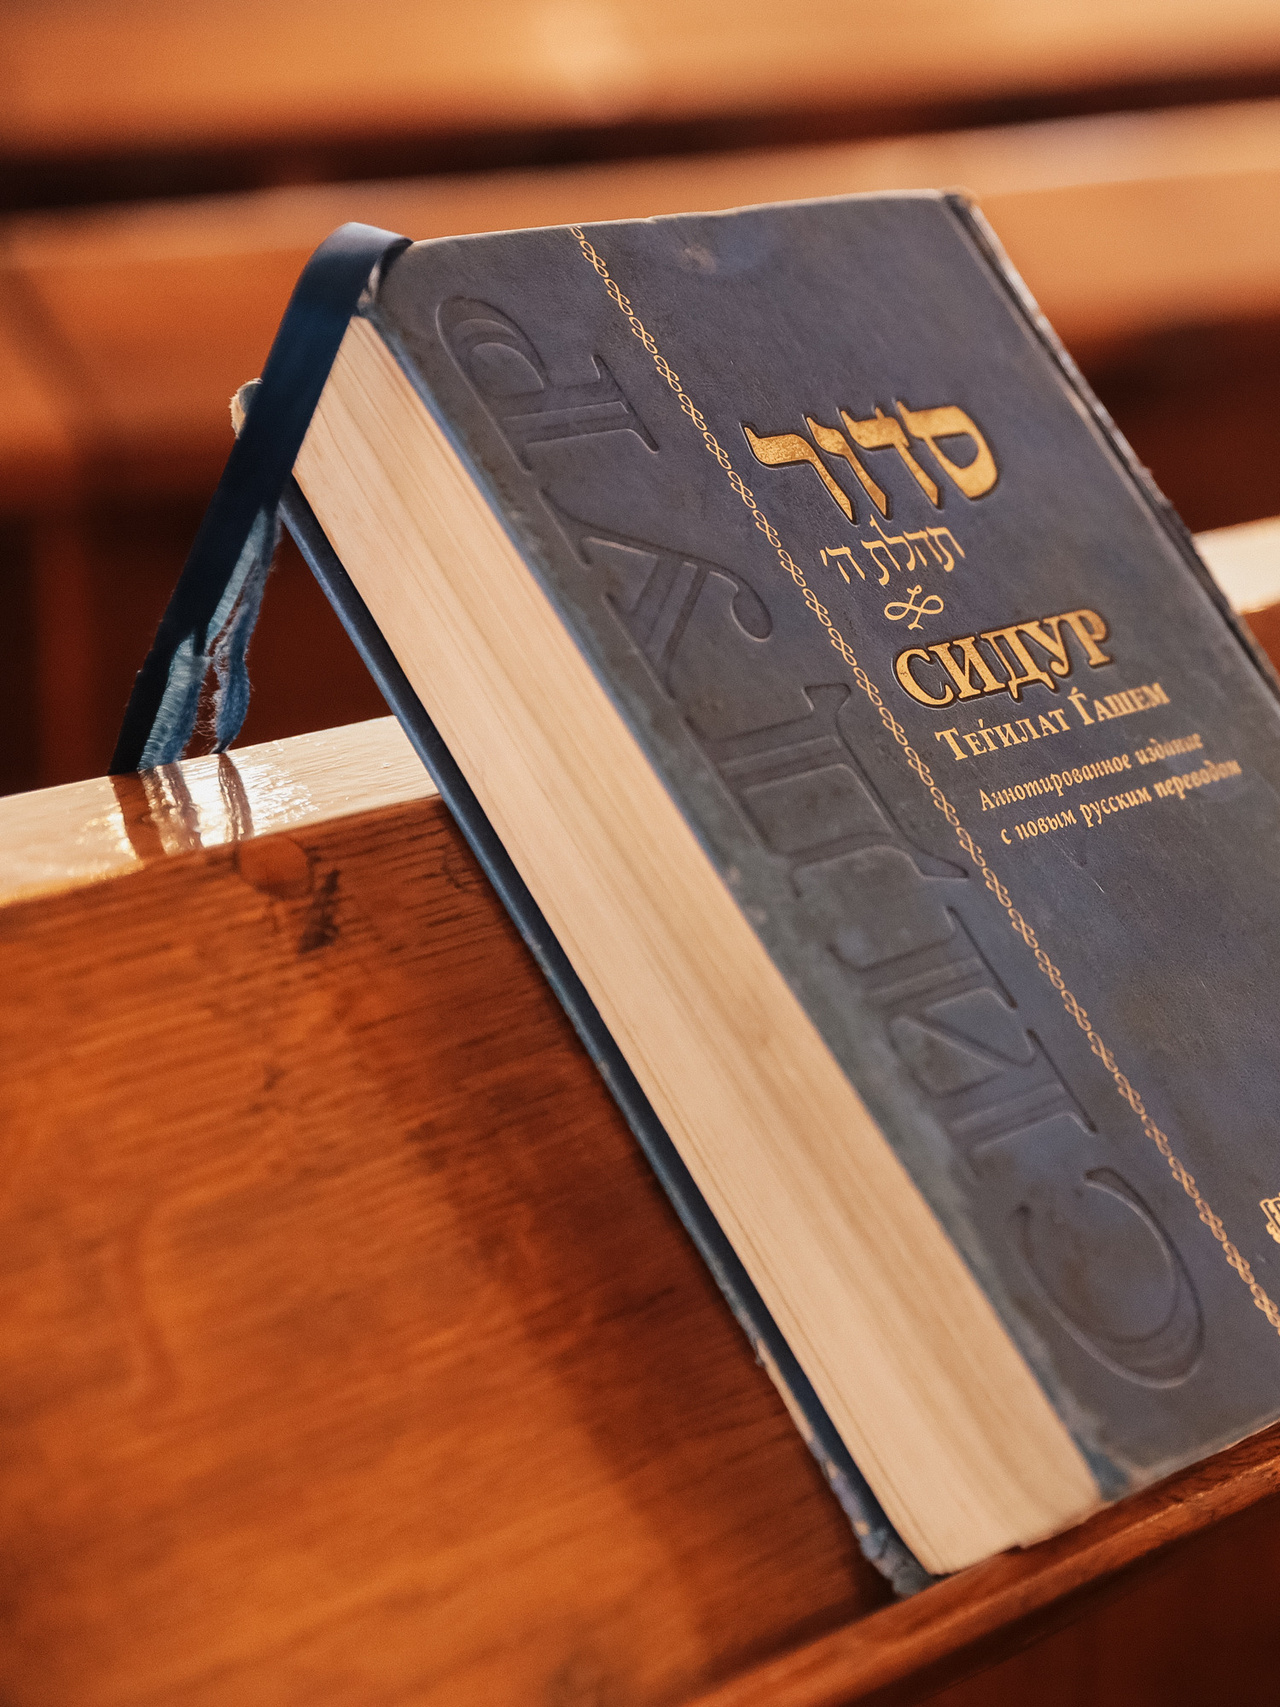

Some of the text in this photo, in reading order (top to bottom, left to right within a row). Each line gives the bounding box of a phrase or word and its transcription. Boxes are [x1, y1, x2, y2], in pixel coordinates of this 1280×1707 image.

[740, 399, 999, 525] סדור
[860, 513, 966, 587] תהלת
[893, 608, 1112, 709] СИДУР
[978, 732, 1204, 812] Аннотированное издание
[1000, 758, 1243, 846] с новым русским переводом
[435, 295, 1207, 1390] СИДУР
